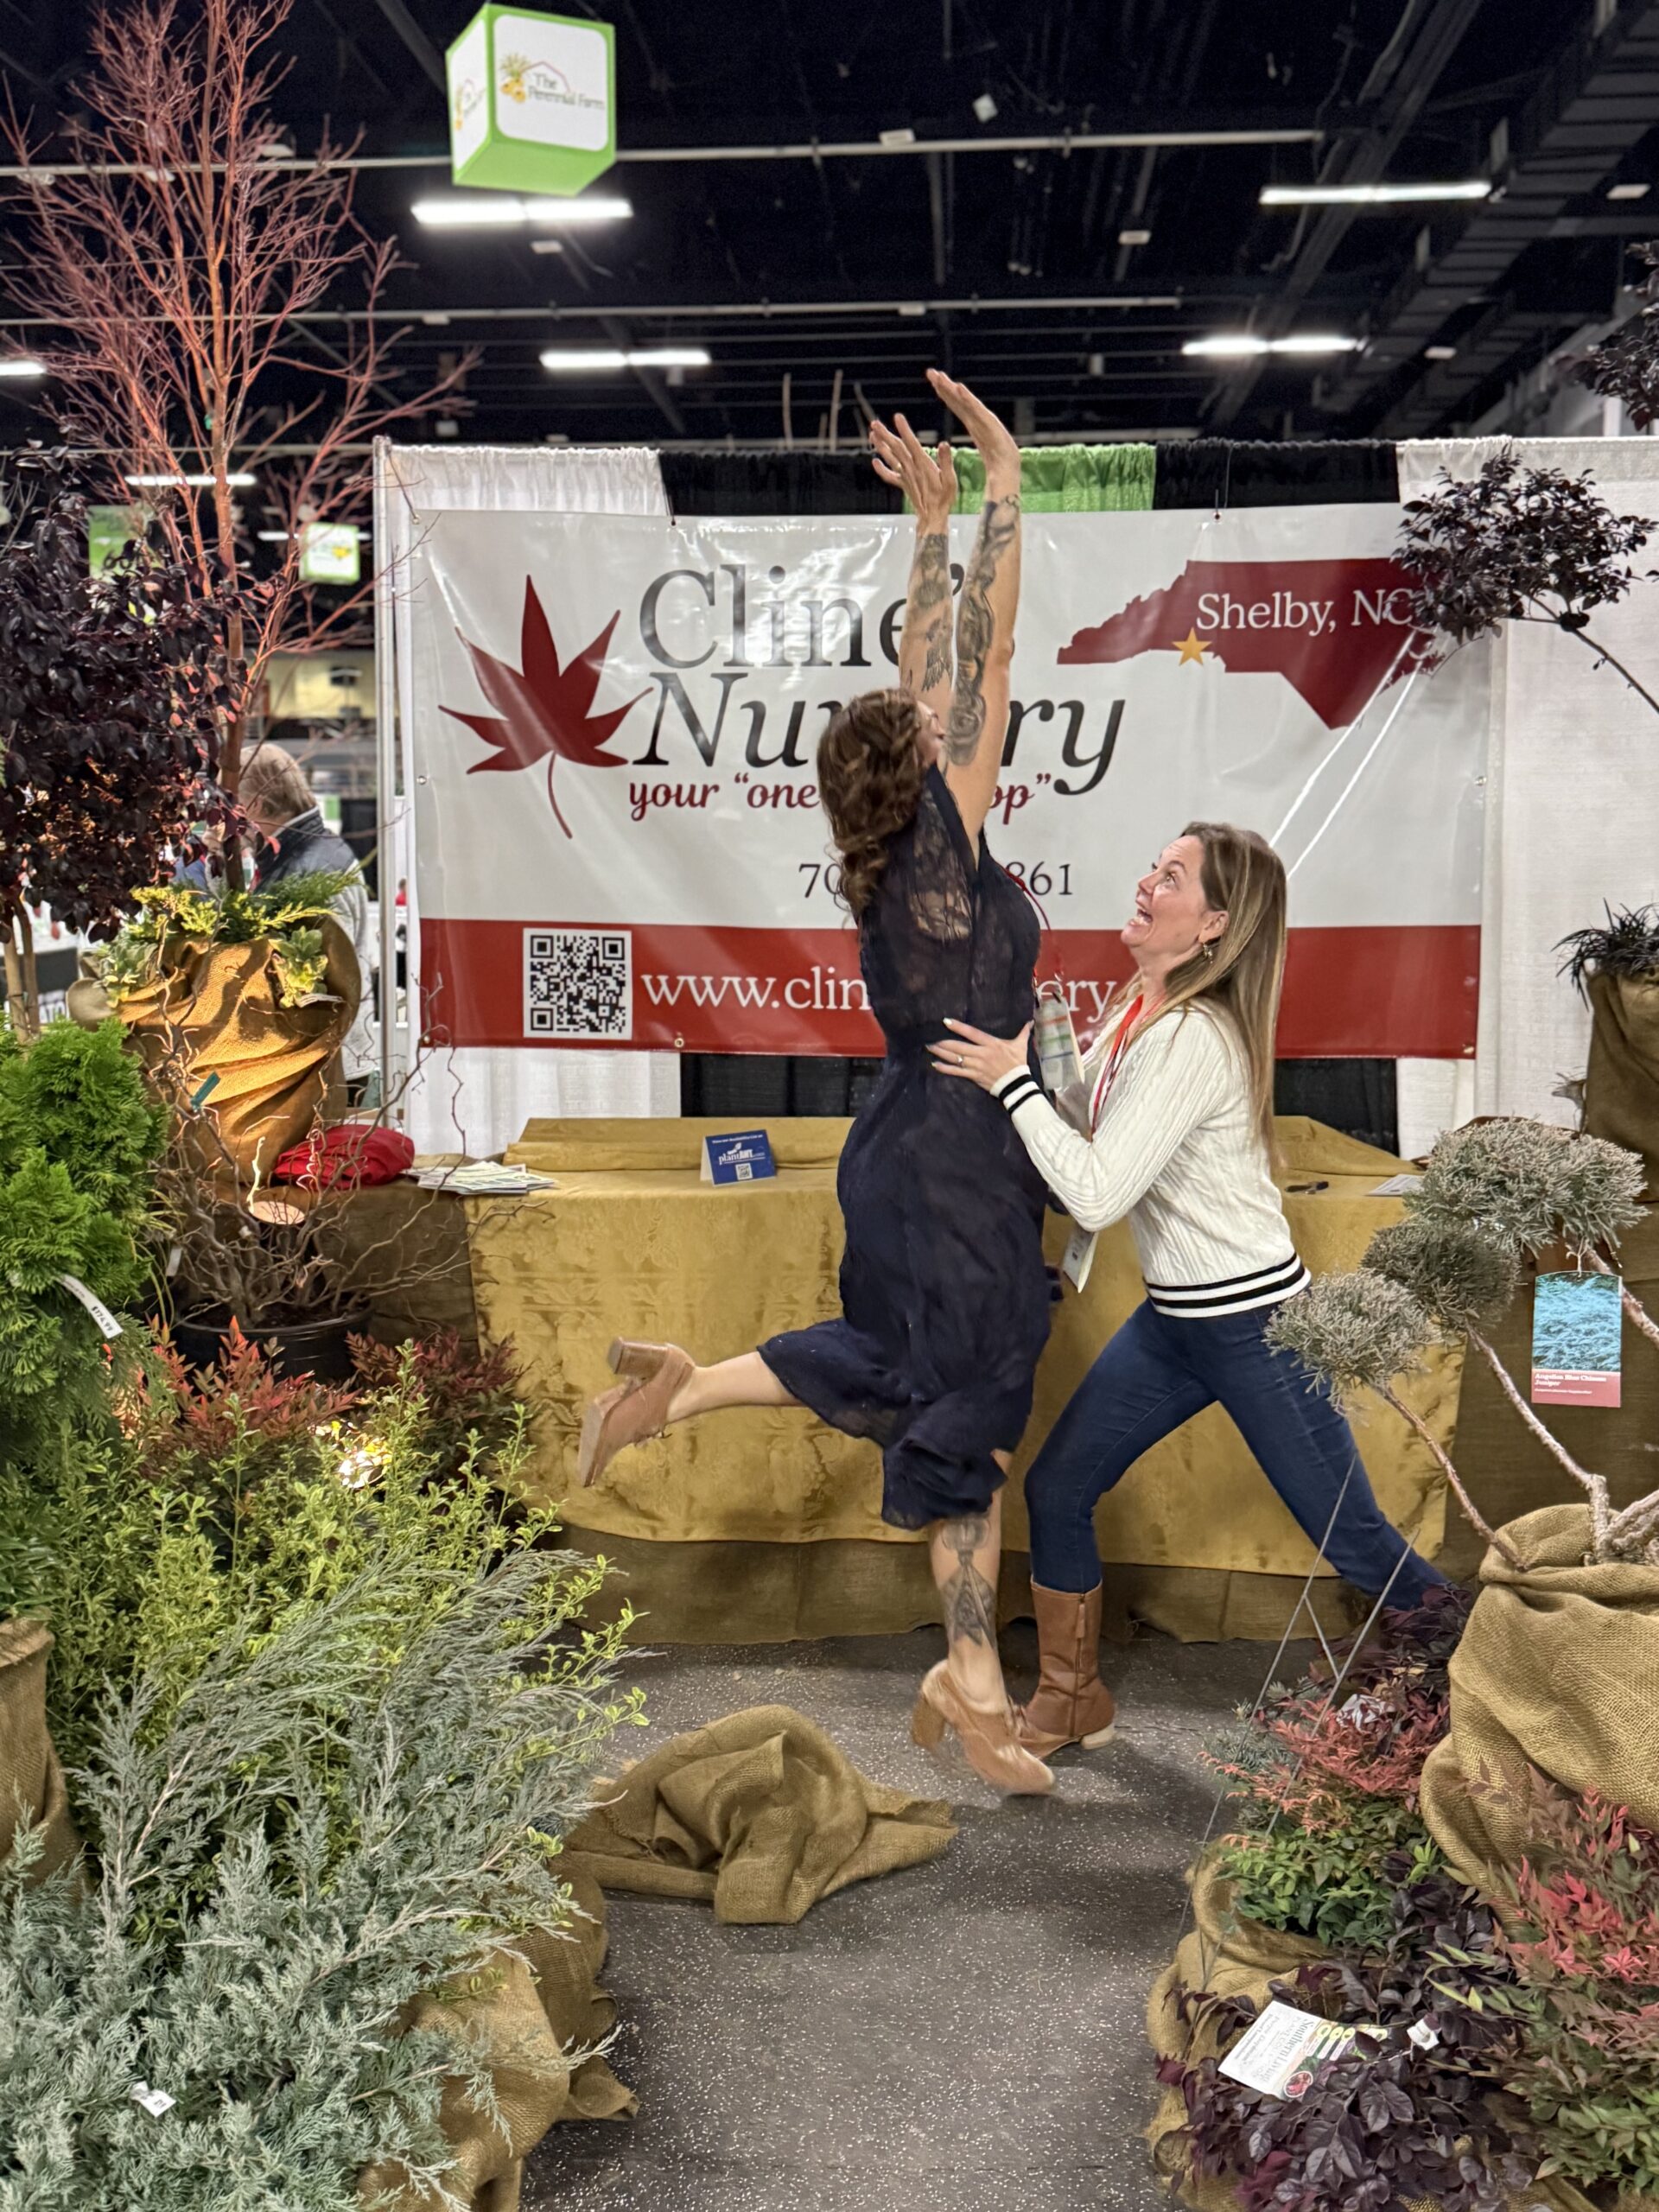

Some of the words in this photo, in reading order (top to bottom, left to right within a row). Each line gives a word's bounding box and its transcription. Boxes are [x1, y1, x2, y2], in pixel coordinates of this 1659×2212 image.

[534, 73, 557, 89] The
[1197, 591, 1336, 636] Shelby,
[1351, 588, 1413, 626] NC
[629, 782, 720, 821] your
[1280, 2018, 1314, 2057] Southern
